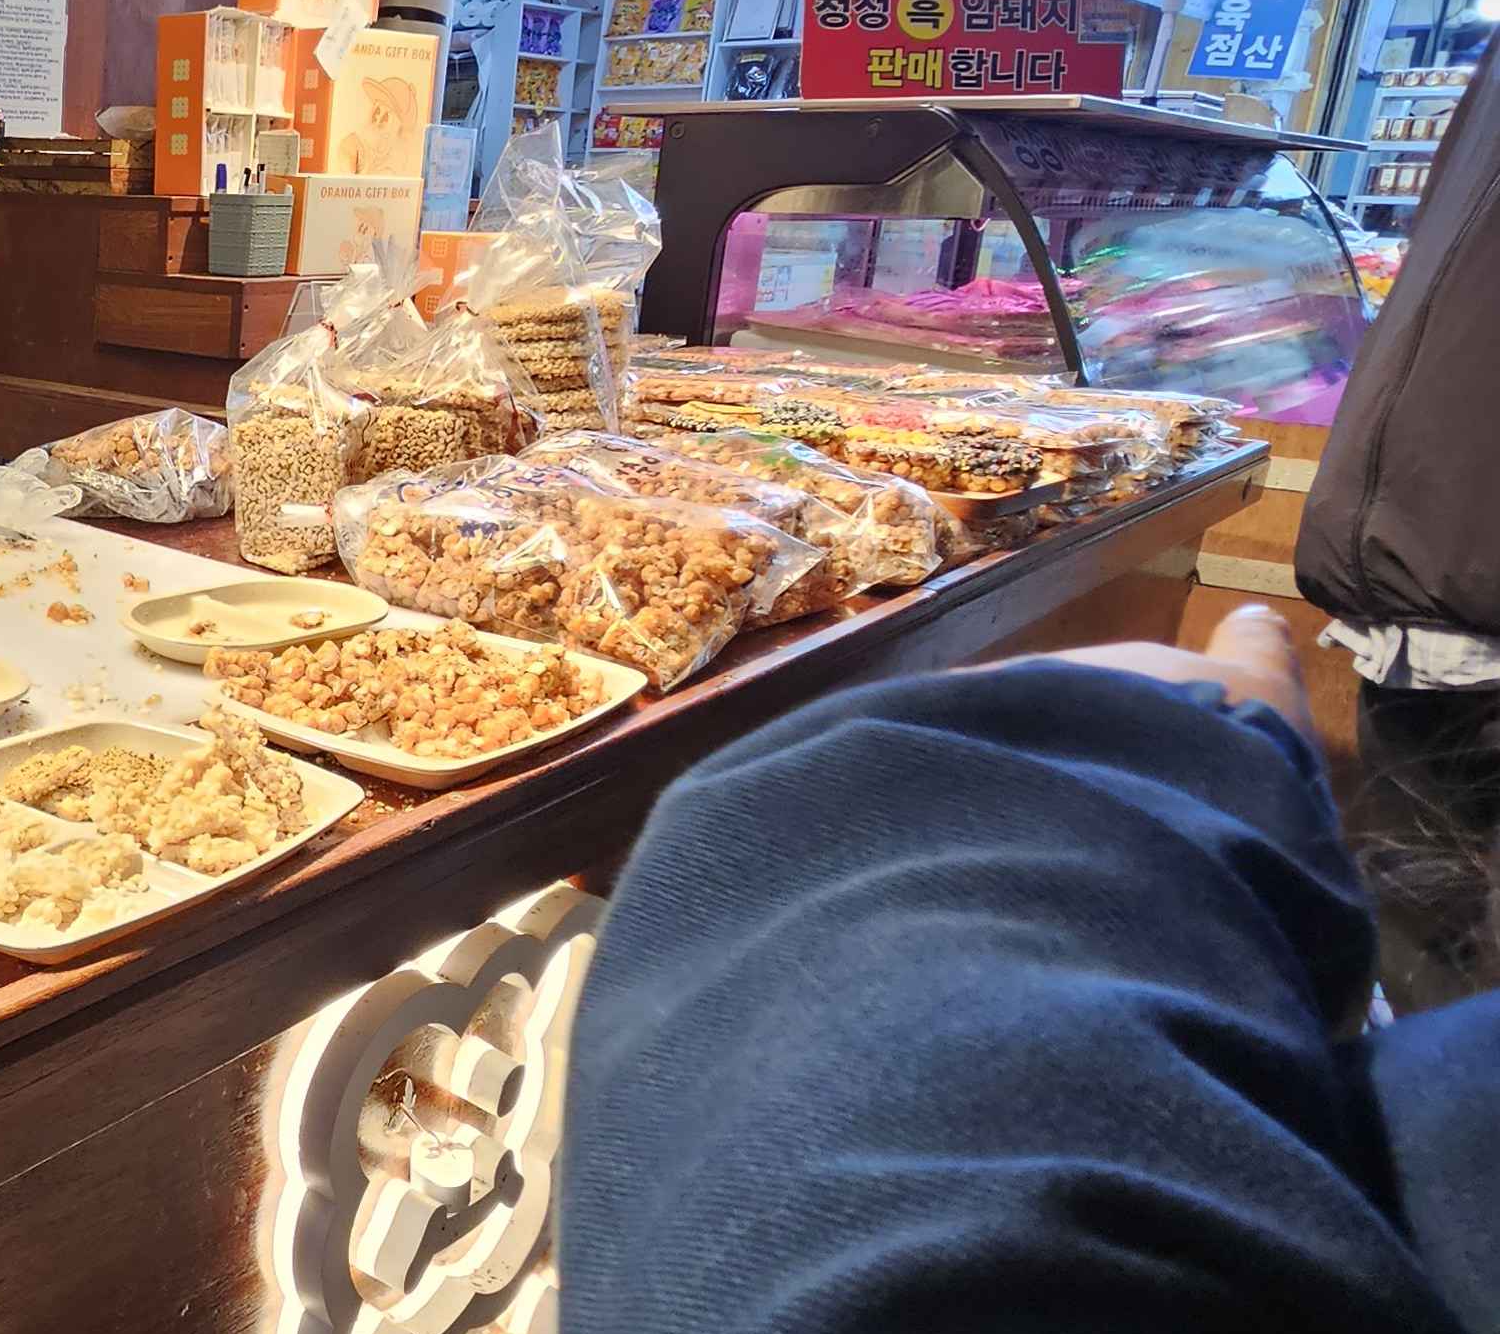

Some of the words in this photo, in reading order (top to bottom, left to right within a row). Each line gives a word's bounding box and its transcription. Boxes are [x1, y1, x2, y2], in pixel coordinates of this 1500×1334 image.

[386, 46, 409, 59] GIFT
[412, 47, 432, 61] BOX
[320, 186, 363, 199] ORANDA
[365, 186, 389, 199] GIFT
[391, 187, 411, 199] BOX
